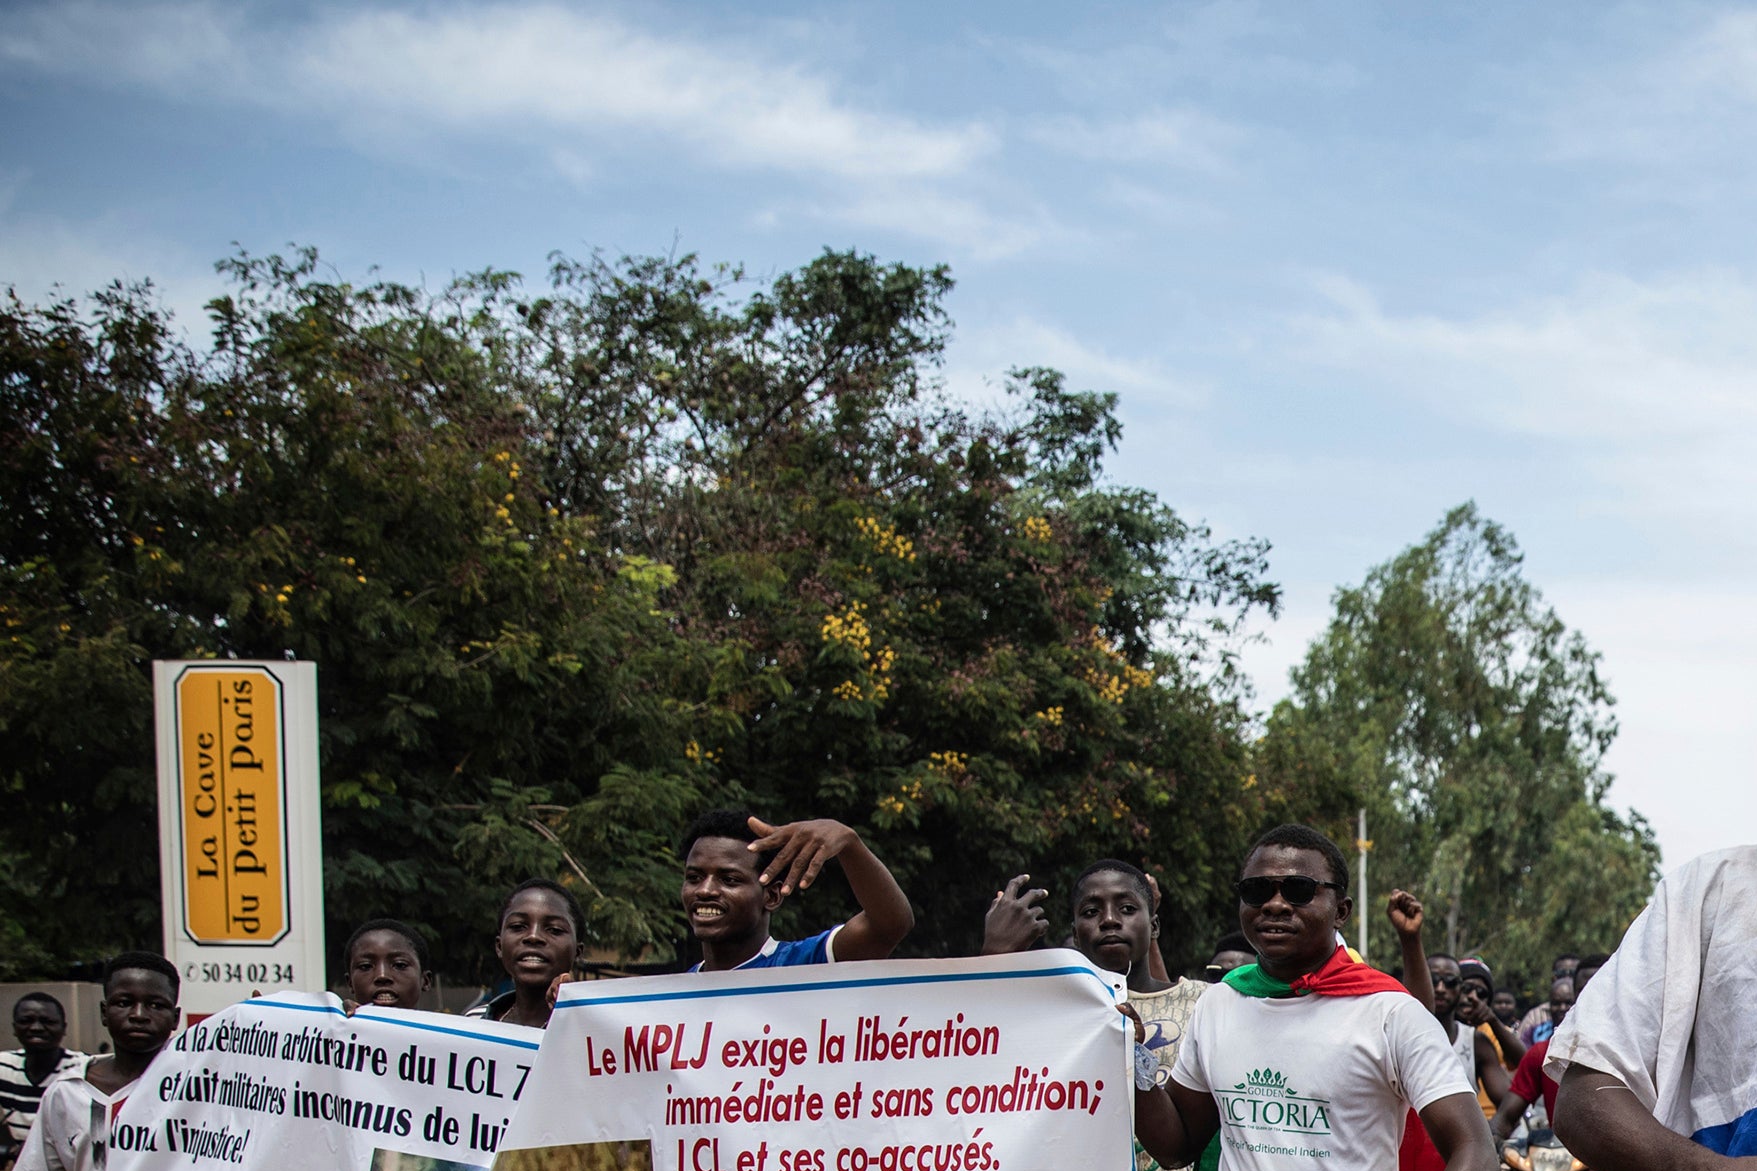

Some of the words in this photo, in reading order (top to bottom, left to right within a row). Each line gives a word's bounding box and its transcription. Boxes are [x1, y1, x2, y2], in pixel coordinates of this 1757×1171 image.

[194, 732, 217, 818] Cave
[197, 835, 219, 880] La
[232, 895, 260, 934] du
[202, 963, 220, 982] 50
[224, 963, 242, 982] 34
[247, 963, 267, 982] 02
[273, 963, 293, 983] 34
[191, 1023, 207, 1052] la
[281, 1026, 387, 1076] arbitraire
[399, 1045, 436, 1085] du
[447, 1052, 504, 1098] LCL
[586, 1036, 617, 1077] Le
[624, 1021, 713, 1073] MPLJ
[721, 1024, 808, 1077] exige
[818, 1018, 845, 1064] la
[855, 1013, 999, 1062] libération
[159, 1071, 182, 1102] et
[220, 1072, 286, 1115] militaires
[294, 1081, 412, 1137] inconnus
[424, 1106, 460, 1145] de
[665, 1078, 823, 1126] immédiate
[834, 1082, 862, 1119] et
[870, 1082, 934, 1119] sans
[946, 1066, 1104, 1116] condition;
[1247, 1087, 1285, 1098] GOLDEN
[166, 1118, 250, 1164] l'injustice!
[1300, 1147, 1331, 1158] Indien
